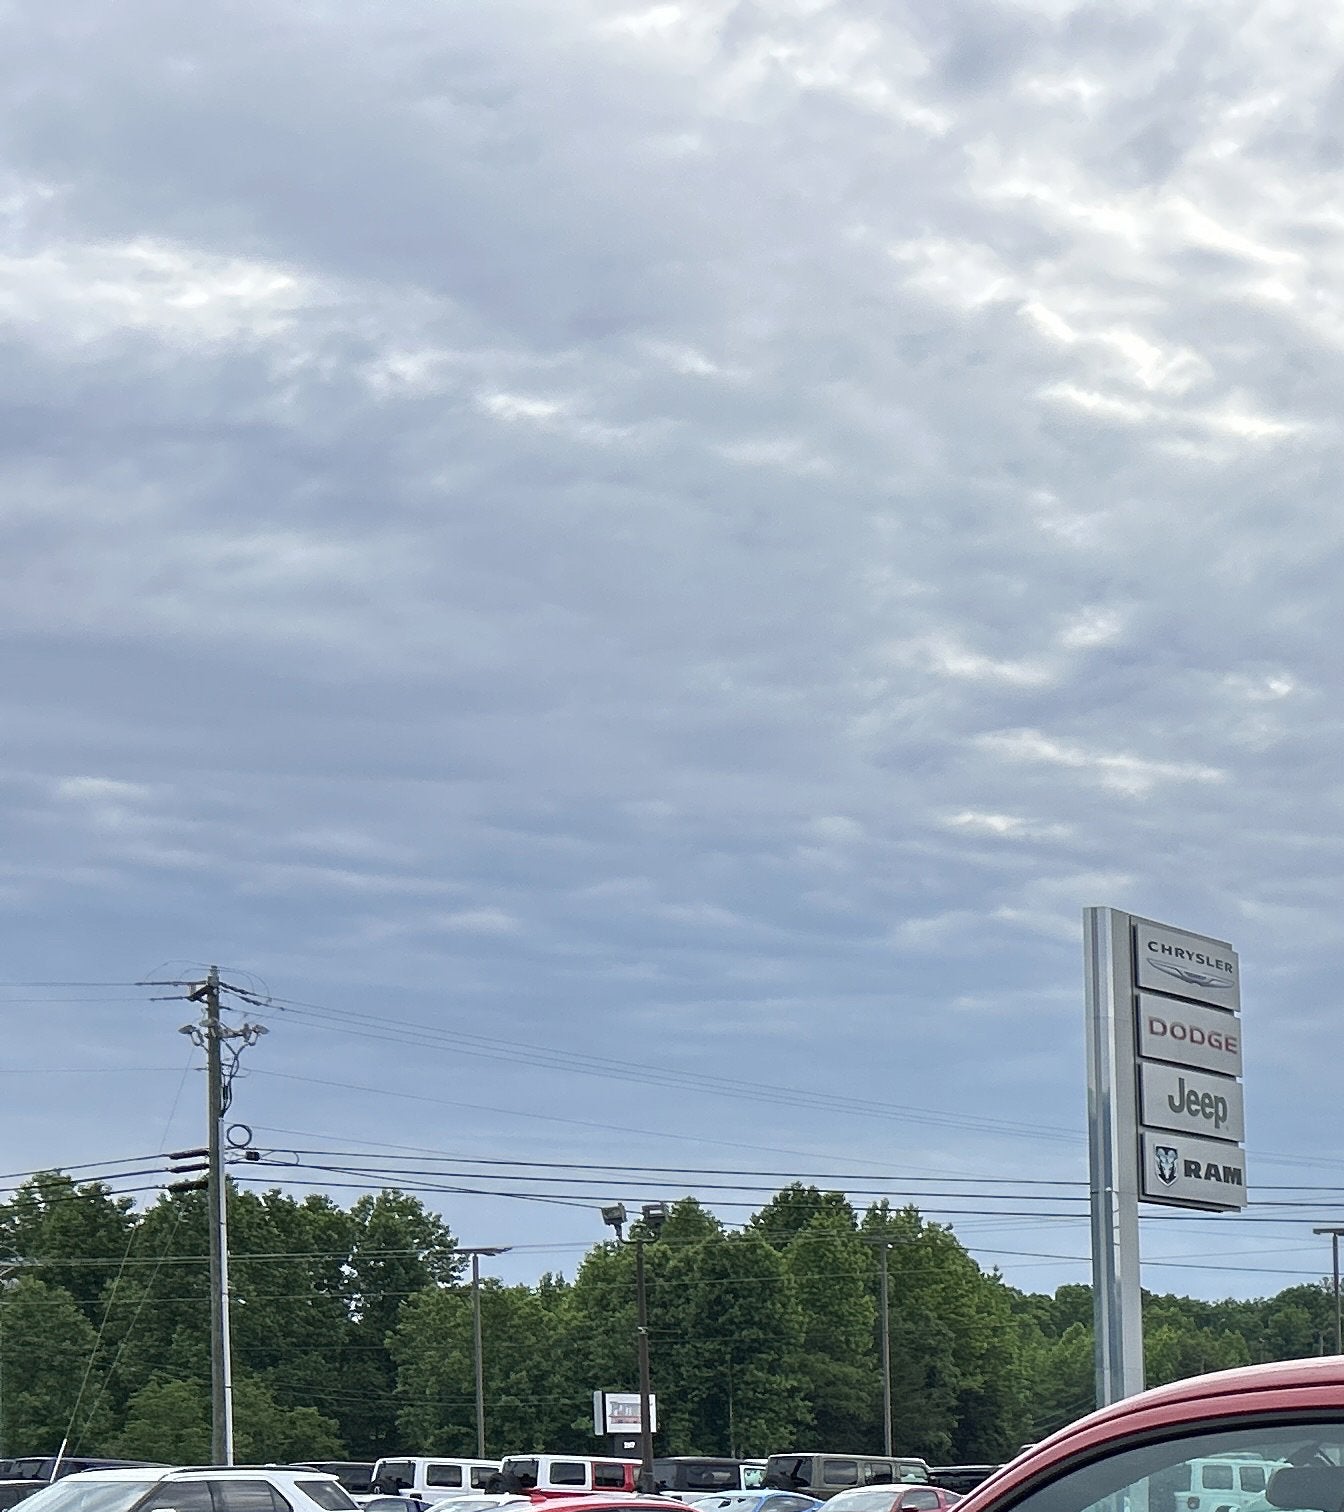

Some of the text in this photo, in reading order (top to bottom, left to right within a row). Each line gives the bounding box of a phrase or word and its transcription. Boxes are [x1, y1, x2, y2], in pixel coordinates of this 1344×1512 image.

[1148, 940, 1234, 974] CHRYSLER
[1149, 1016, 1238, 1054] DODGE
[1167, 1077, 1228, 1129] Jeep
[1183, 1159, 1243, 1186] RAM
